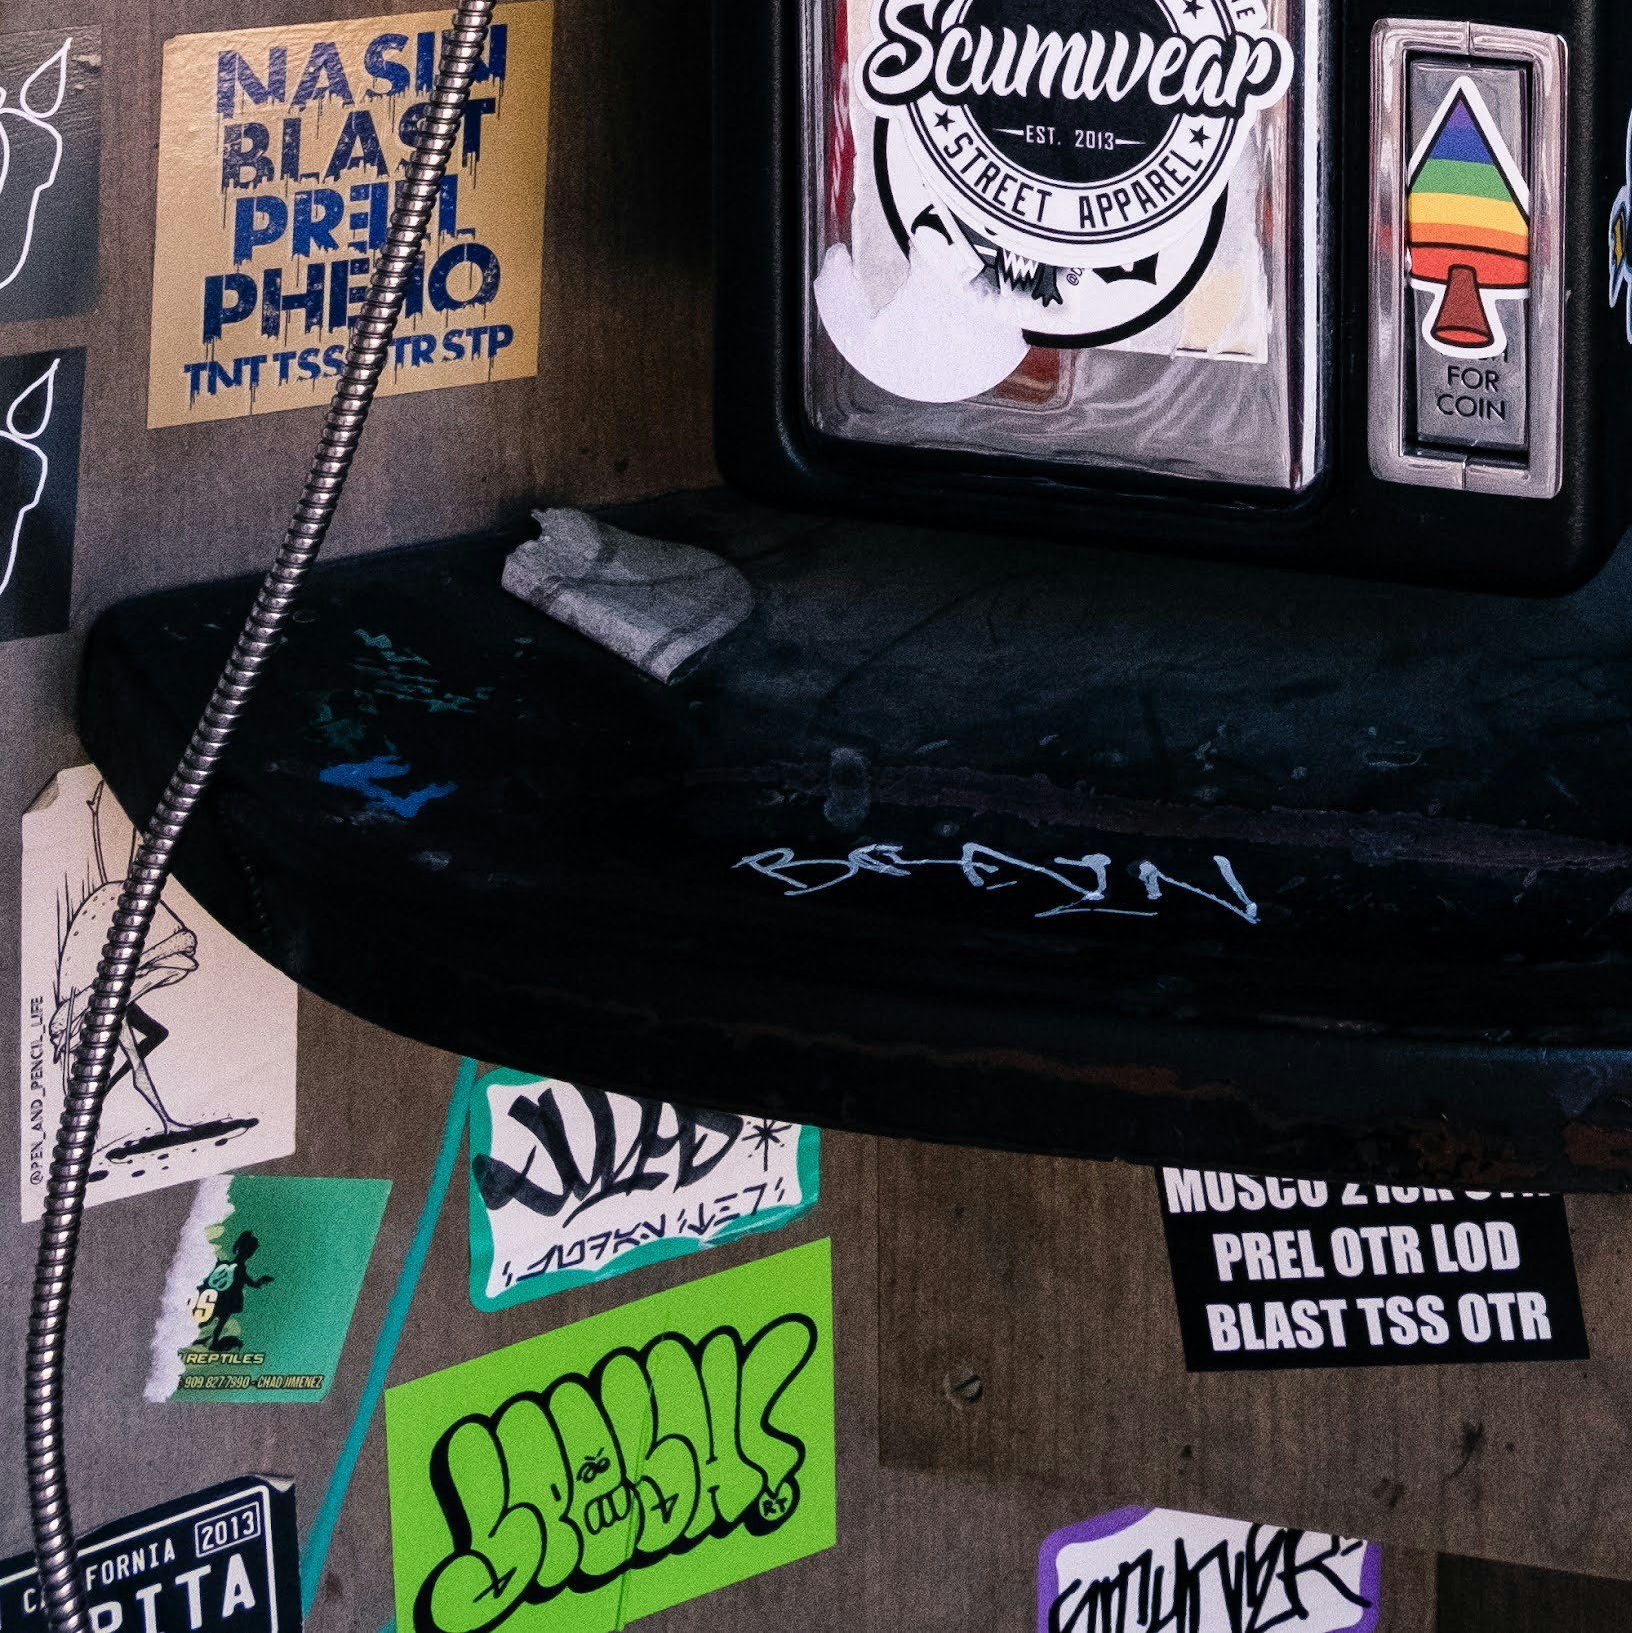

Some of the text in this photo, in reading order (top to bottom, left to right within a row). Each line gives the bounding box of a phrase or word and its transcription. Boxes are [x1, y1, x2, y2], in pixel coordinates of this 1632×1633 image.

[1024, 126, 1117, 153] EST. 2013
[942, 129, 1206, 233] STREET APPAREL
[185, 324, 514, 397] TNT STP
[1446, 366, 1500, 395] FOR
[1436, 392, 1507, 423] COIN
[1212, 1218, 1521, 1283] PREL OTR LOD
[1206, 1288, 1552, 1353] BLAST TSS OTR
[199, 1511, 258, 1551] 2013
